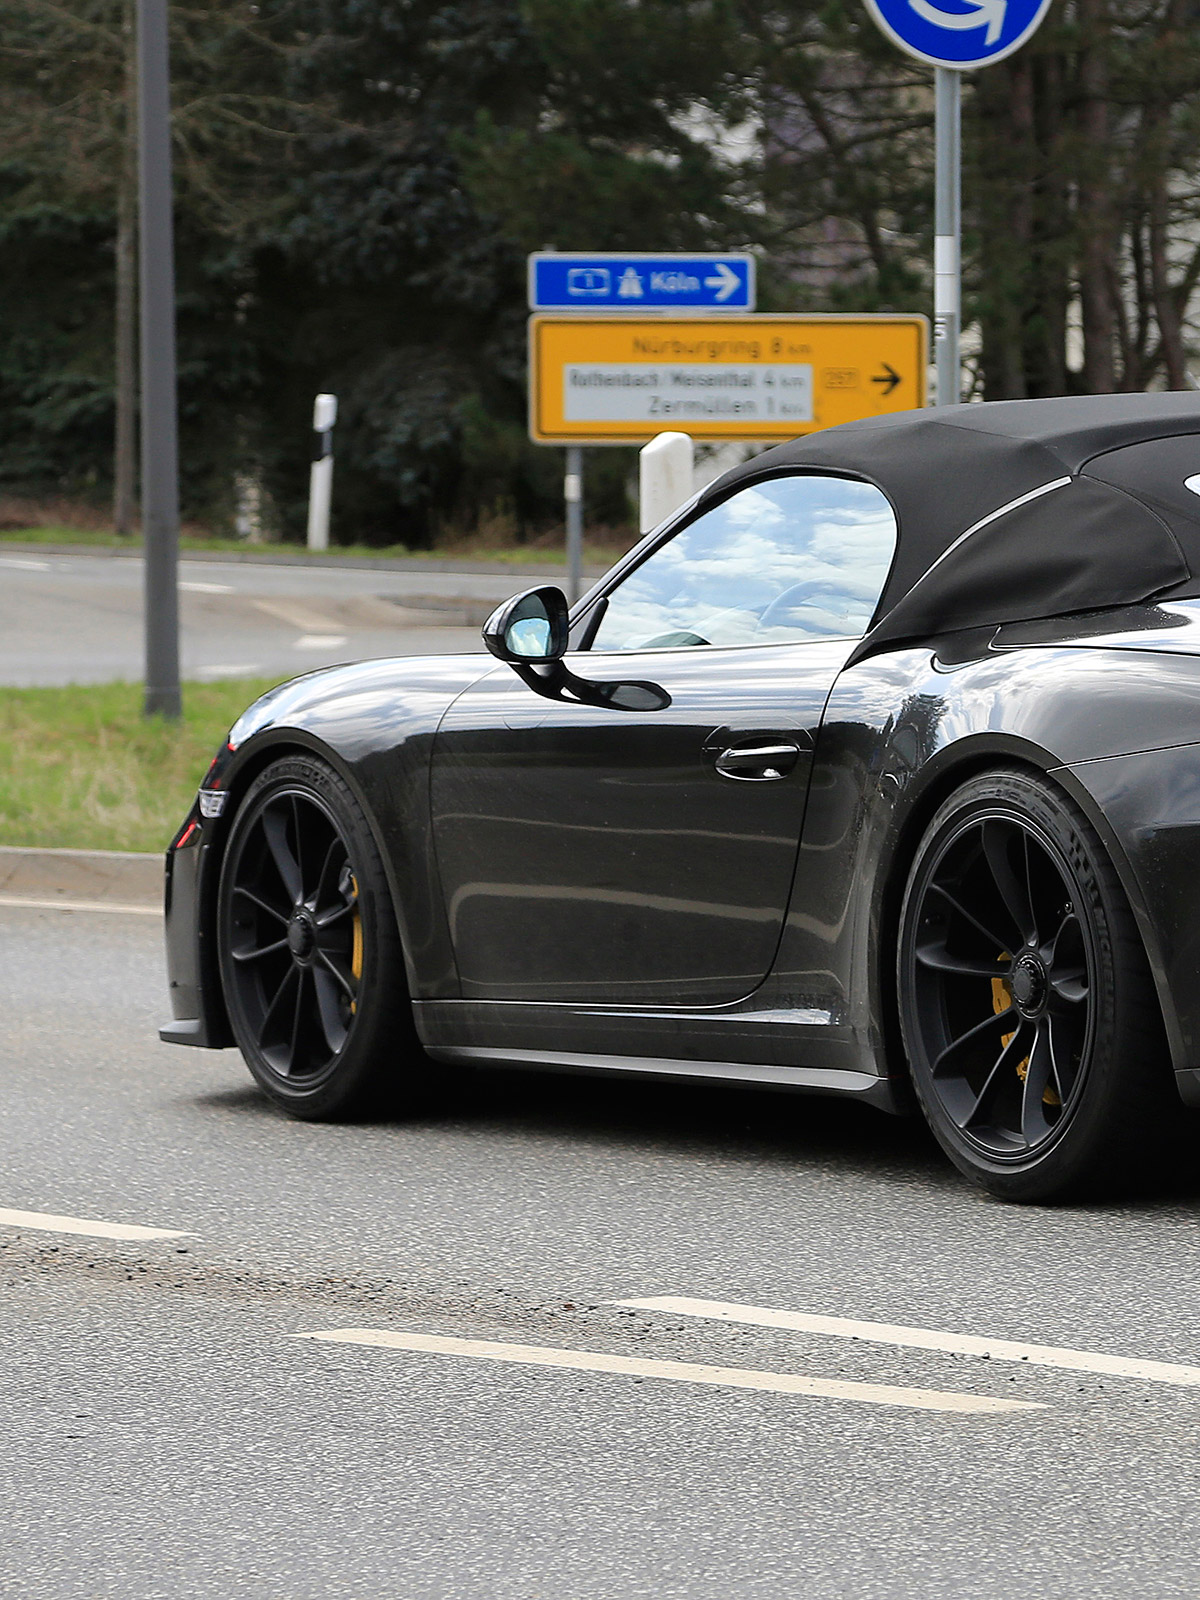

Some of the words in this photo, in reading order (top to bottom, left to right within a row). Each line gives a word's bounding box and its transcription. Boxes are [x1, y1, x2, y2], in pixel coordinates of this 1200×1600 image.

[650, 271, 700, 293] Köln
[632, 336, 760, 359] Nürburgring
[763, 369, 774, 386] 4
[648, 395, 757, 414] Zermüllen
